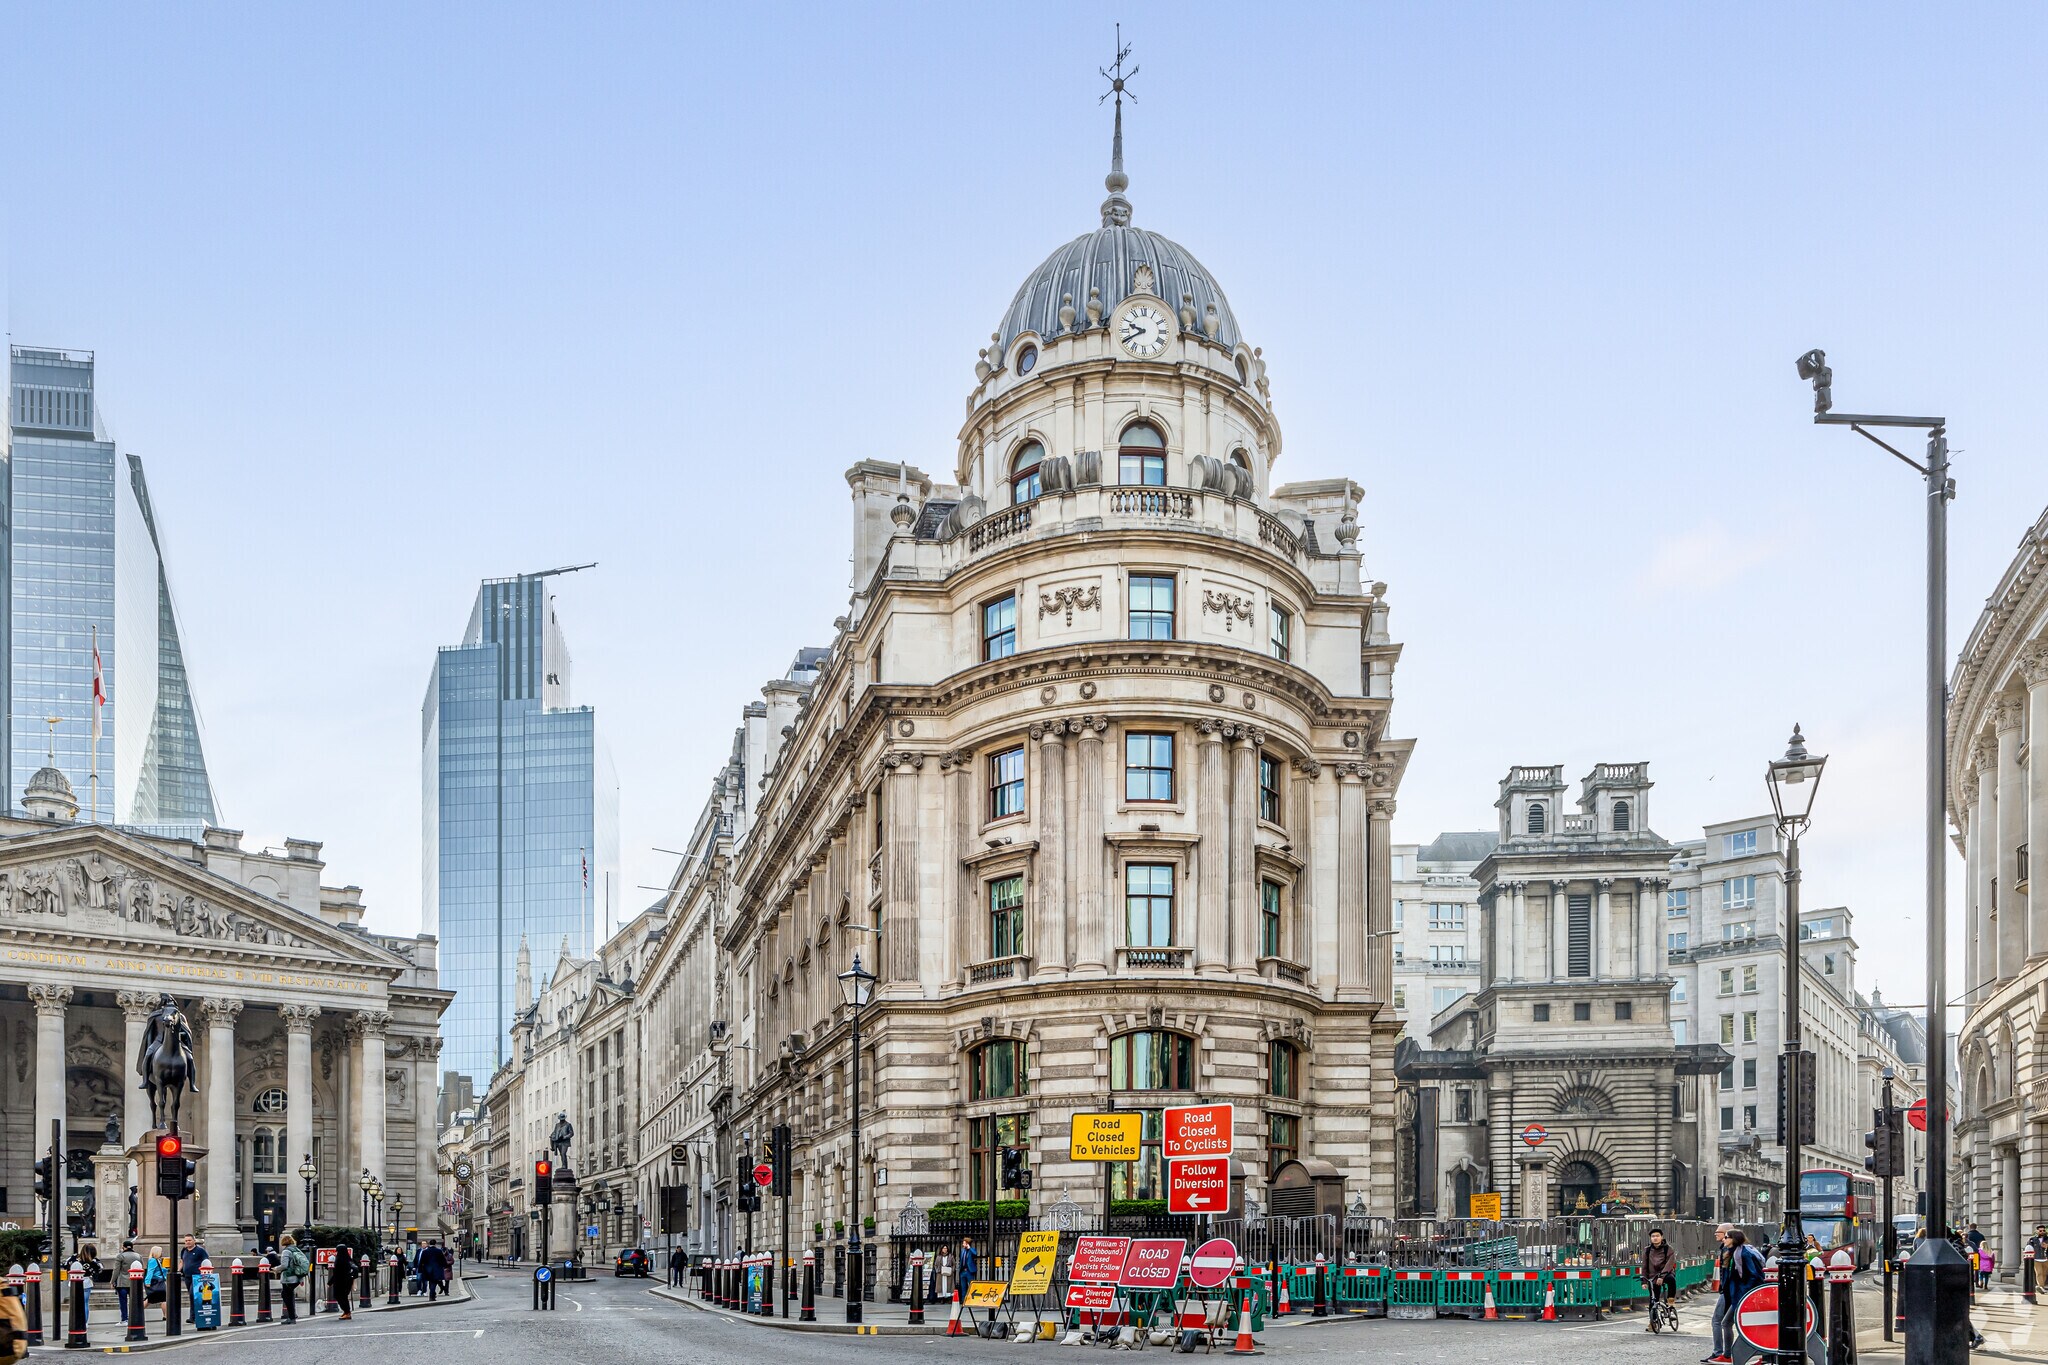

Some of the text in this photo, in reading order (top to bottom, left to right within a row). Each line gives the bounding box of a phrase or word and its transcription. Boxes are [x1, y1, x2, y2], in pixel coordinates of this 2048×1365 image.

[8, 950, 86, 967] CONDITVM
[106, 959, 146, 972] ANNO
[155, 963, 226, 978] VICTORIAE
[279, 975, 369, 992] RESTAVRATVM
[1184, 1112, 1212, 1123] Road
[1093, 1119, 1120, 1128] Road
[1087, 1132, 1124, 1141] Closed
[1179, 1125, 1216, 1137] Closed
[1075, 1144, 1135, 1155] To Vehicles
[1168, 1138, 1228, 1152] To Cyclists
[1181, 1164, 1217, 1176] Follow
[1174, 1179, 1224, 1189] Diversion
[1022, 1245, 1054, 1254] operation
[1139, 1249, 1170, 1259] ROAD
[1128, 1267, 1170, 1278] CLOSED
[1084, 1297, 1109, 1305] Cyclists
